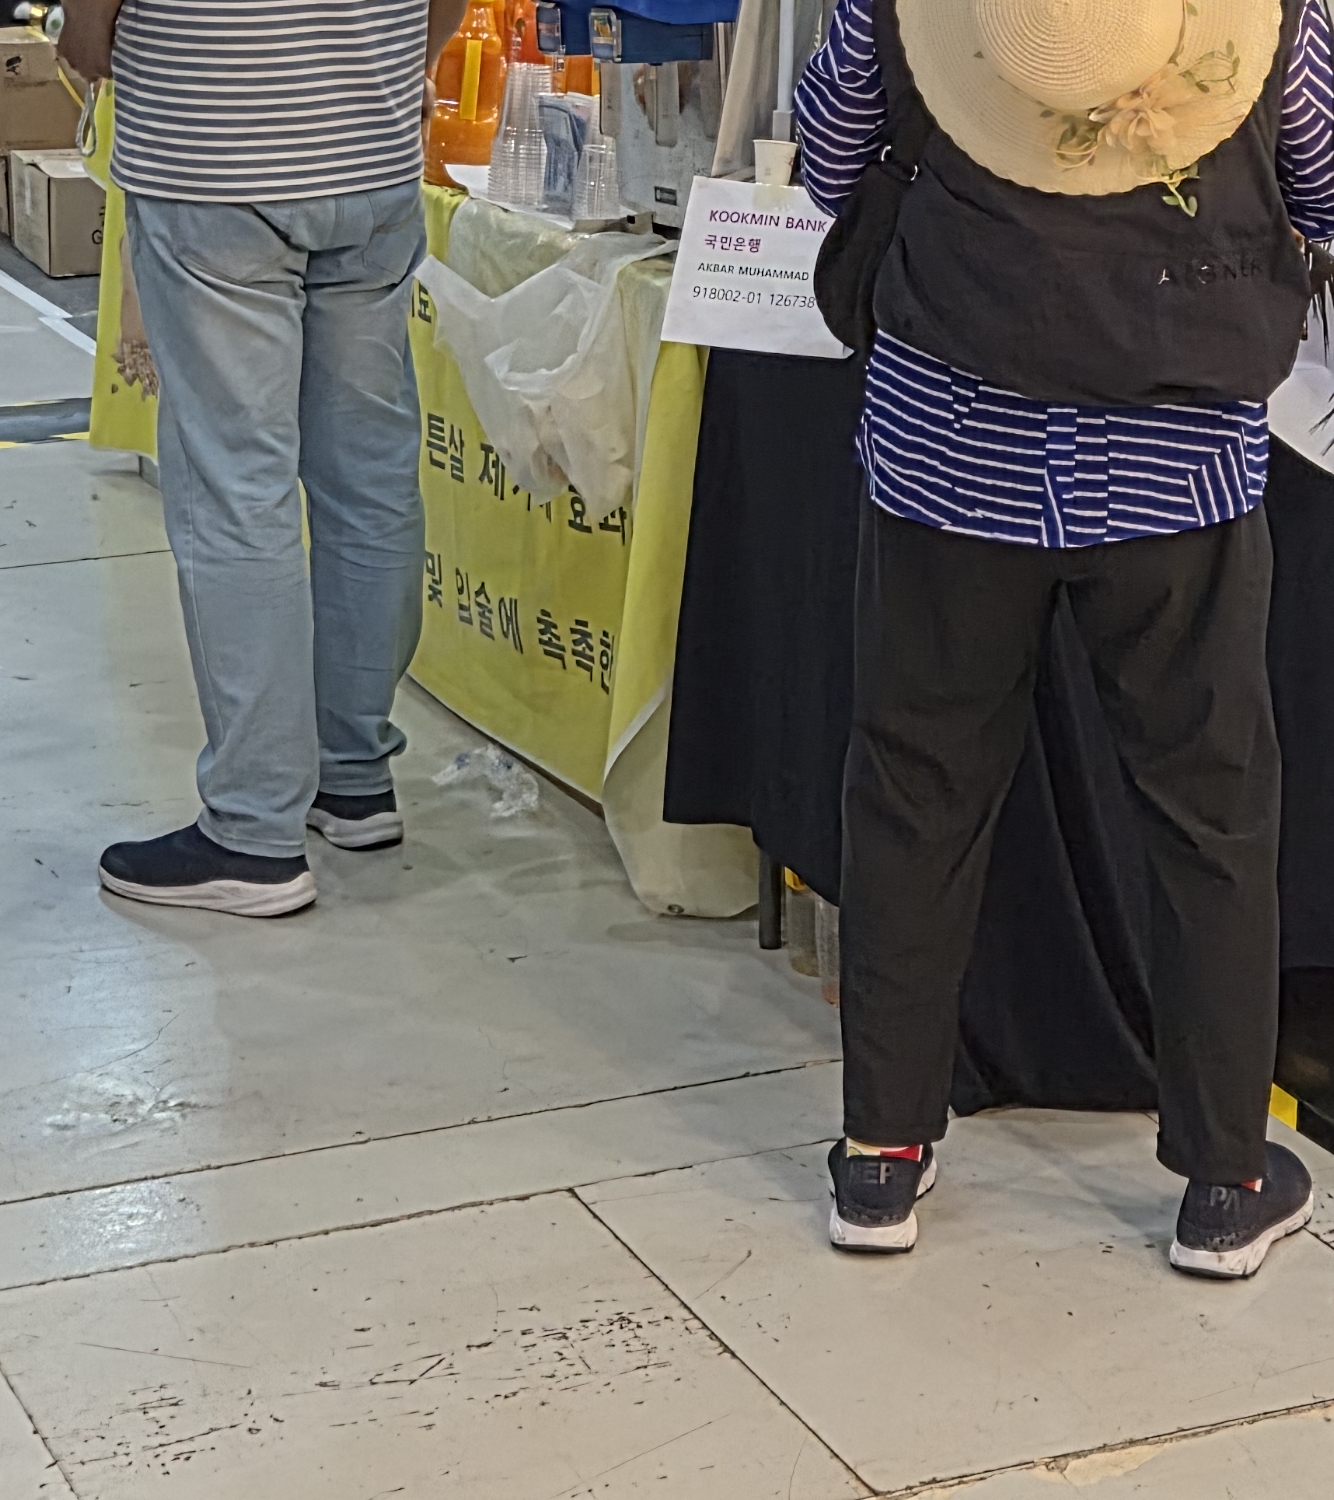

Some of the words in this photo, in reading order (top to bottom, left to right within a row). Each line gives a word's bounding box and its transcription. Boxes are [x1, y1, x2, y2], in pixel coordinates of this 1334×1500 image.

[709, 209, 780, 228] KOOKMIN
[785, 216, 828, 233] BANK
[704, 233, 762, 254] 국민은행
[697, 262, 735, 275] AKBAR
[738, 266, 810, 282] MUHAMMAD
[692, 285, 762, 305] 918002-01
[425, 410, 465, 485] 튼살
[454, 566, 524, 655] 입술에
